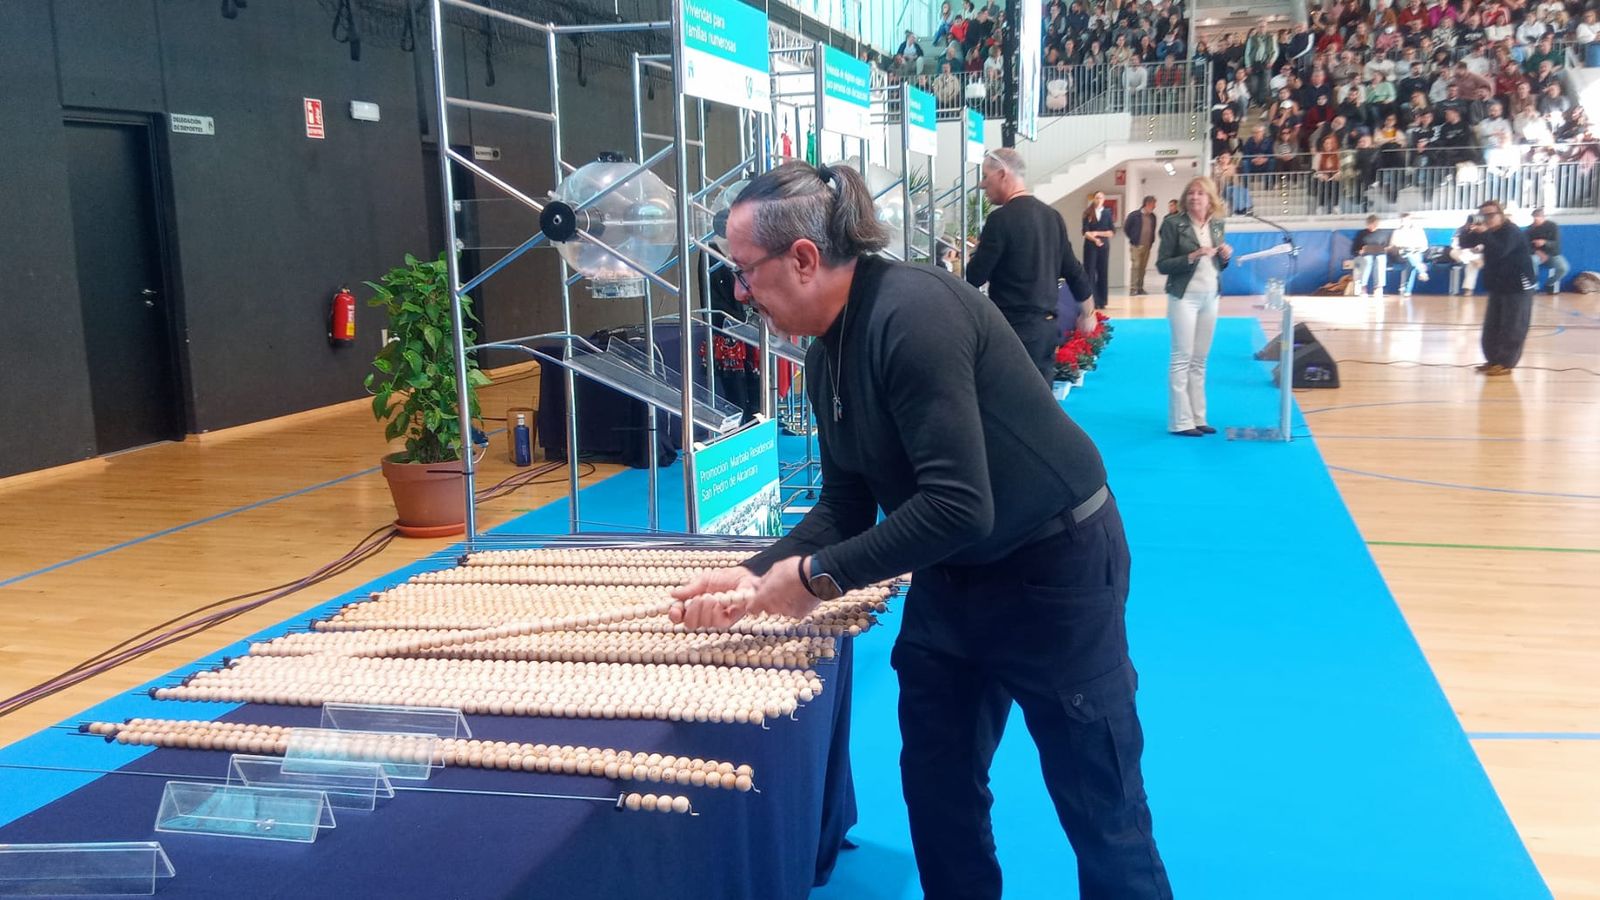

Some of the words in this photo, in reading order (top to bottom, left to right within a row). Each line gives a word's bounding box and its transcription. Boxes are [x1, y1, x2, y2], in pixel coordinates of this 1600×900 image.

[713, 14, 726, 30] para
[685, 20, 708, 43] familias
[708, 33, 737, 54] numerosas
[701, 486, 713, 502] San
[712, 478, 729, 496] Pedro
[729, 473, 736, 488] de
